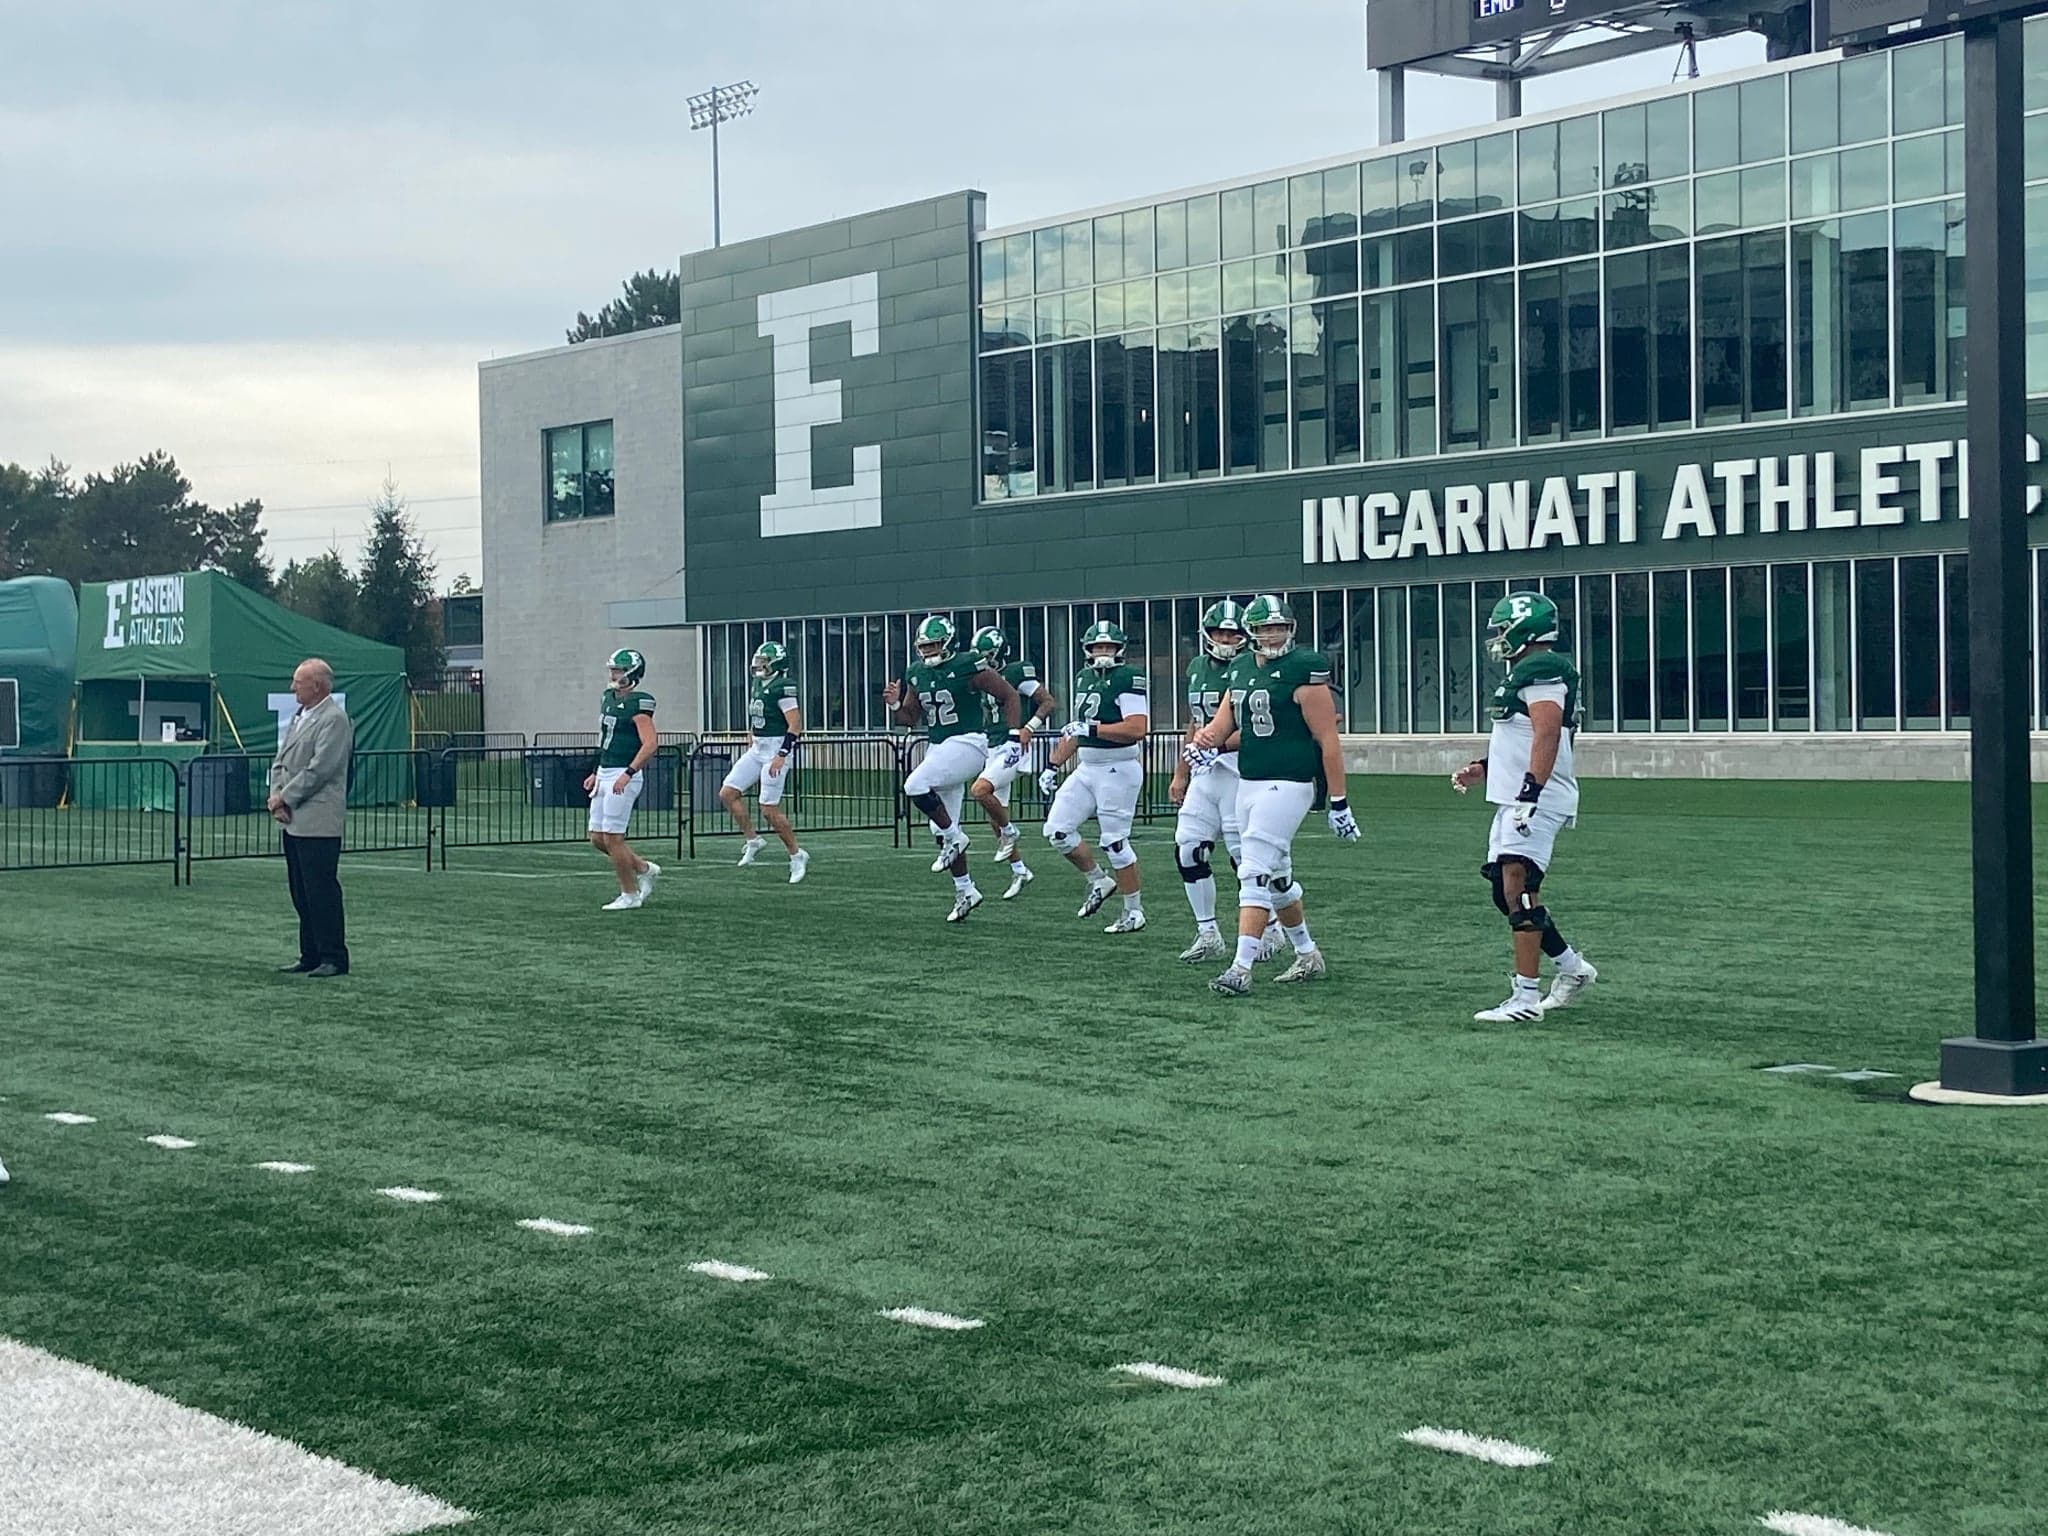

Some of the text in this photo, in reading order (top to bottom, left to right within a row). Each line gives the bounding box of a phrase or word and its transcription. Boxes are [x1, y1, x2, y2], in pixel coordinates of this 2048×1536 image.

[1480, 0, 1514, 17] EMU
[757, 271, 883, 538] E
[1303, 470, 1637, 564] INCARNATI
[130, 576, 184, 615] EASTERN
[1509, 597, 1532, 619] E
[103, 582, 129, 649] E
[128, 617, 184, 646] ATHLETICS
[918, 689, 959, 727] 52
[1231, 689, 1275, 737] 78
